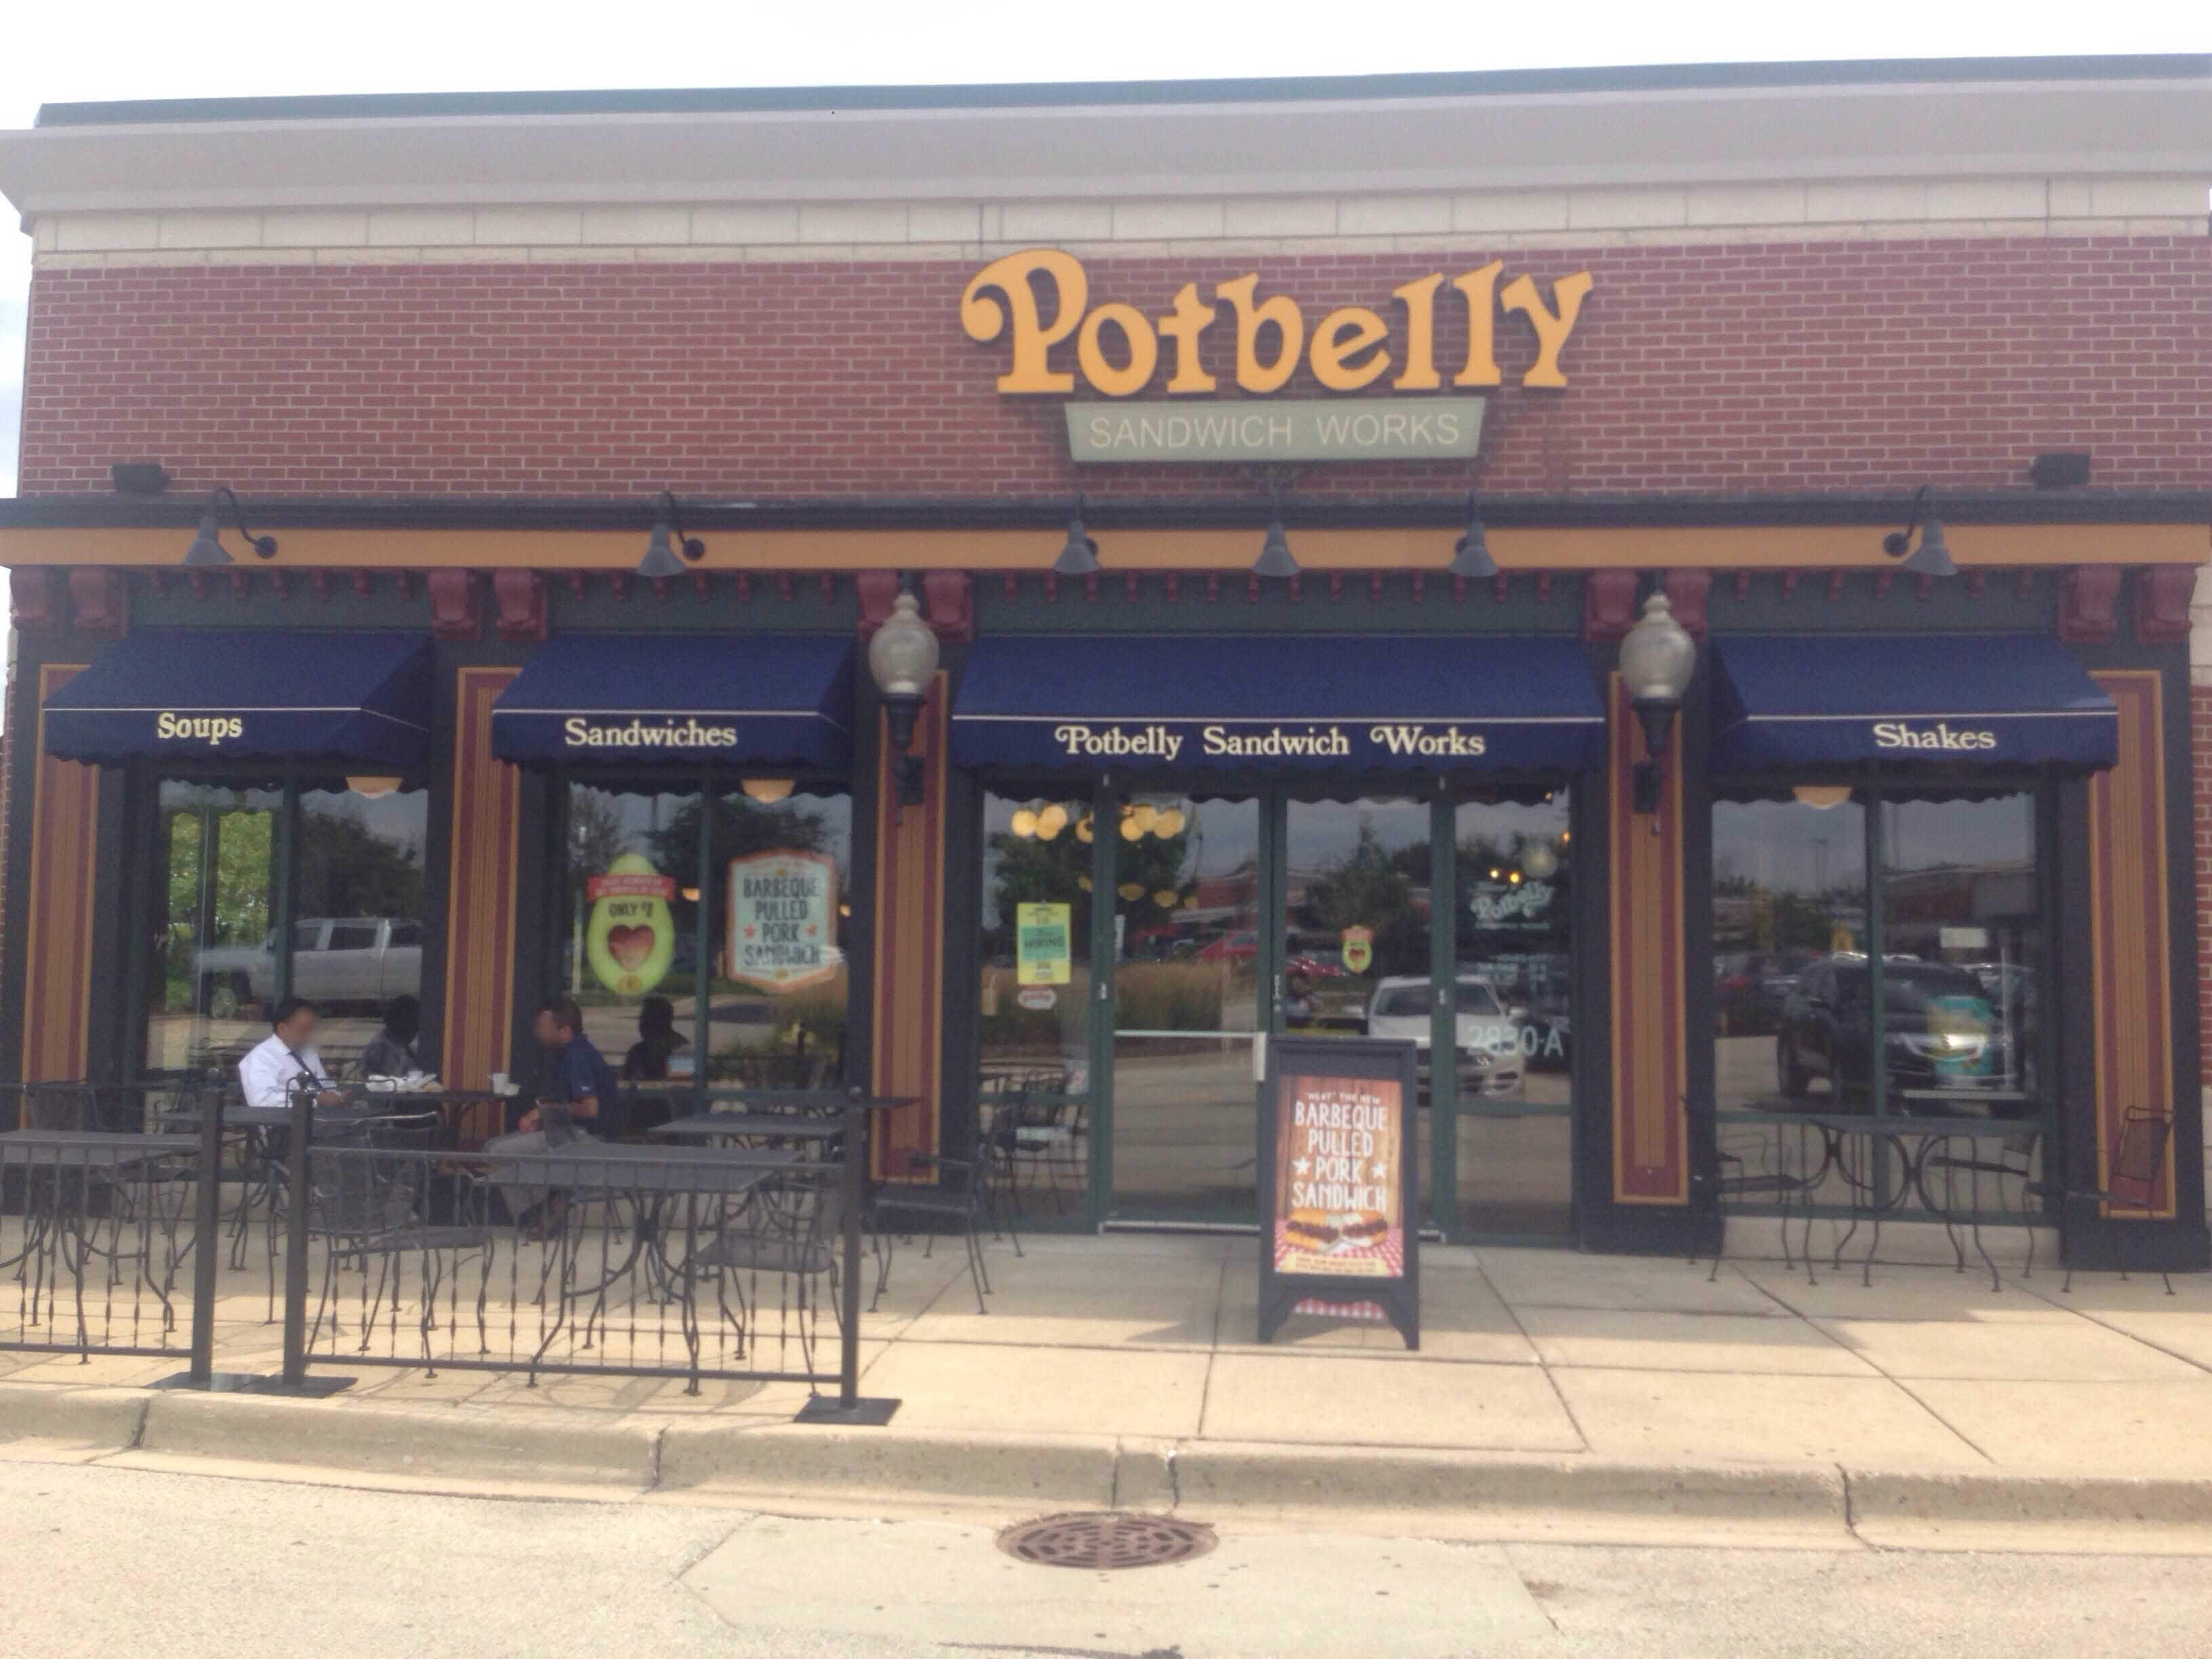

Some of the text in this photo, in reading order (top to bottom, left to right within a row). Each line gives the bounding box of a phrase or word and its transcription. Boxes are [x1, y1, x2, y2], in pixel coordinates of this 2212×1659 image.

[960, 247, 1593, 396] Potbelly
[1088, 413, 1460, 449] SANDWICH WORKS
[157, 712, 243, 745] Soups
[565, 718, 738, 746] Sandwiches
[1054, 726, 1486, 760] Potbelly Sandwich Works
[1872, 723, 1996, 749] Shakes
[743, 878, 819, 898] BARBEQUE
[754, 900, 808, 920] PULLED
[762, 923, 800, 942] PORK
[1294, 1100, 1388, 1130] BARBEQUE
[1307, 1128, 1374, 1158] PULLED
[1315, 1156, 1362, 1183] PORK
[1292, 1181, 1388, 1215] SANDWICH
